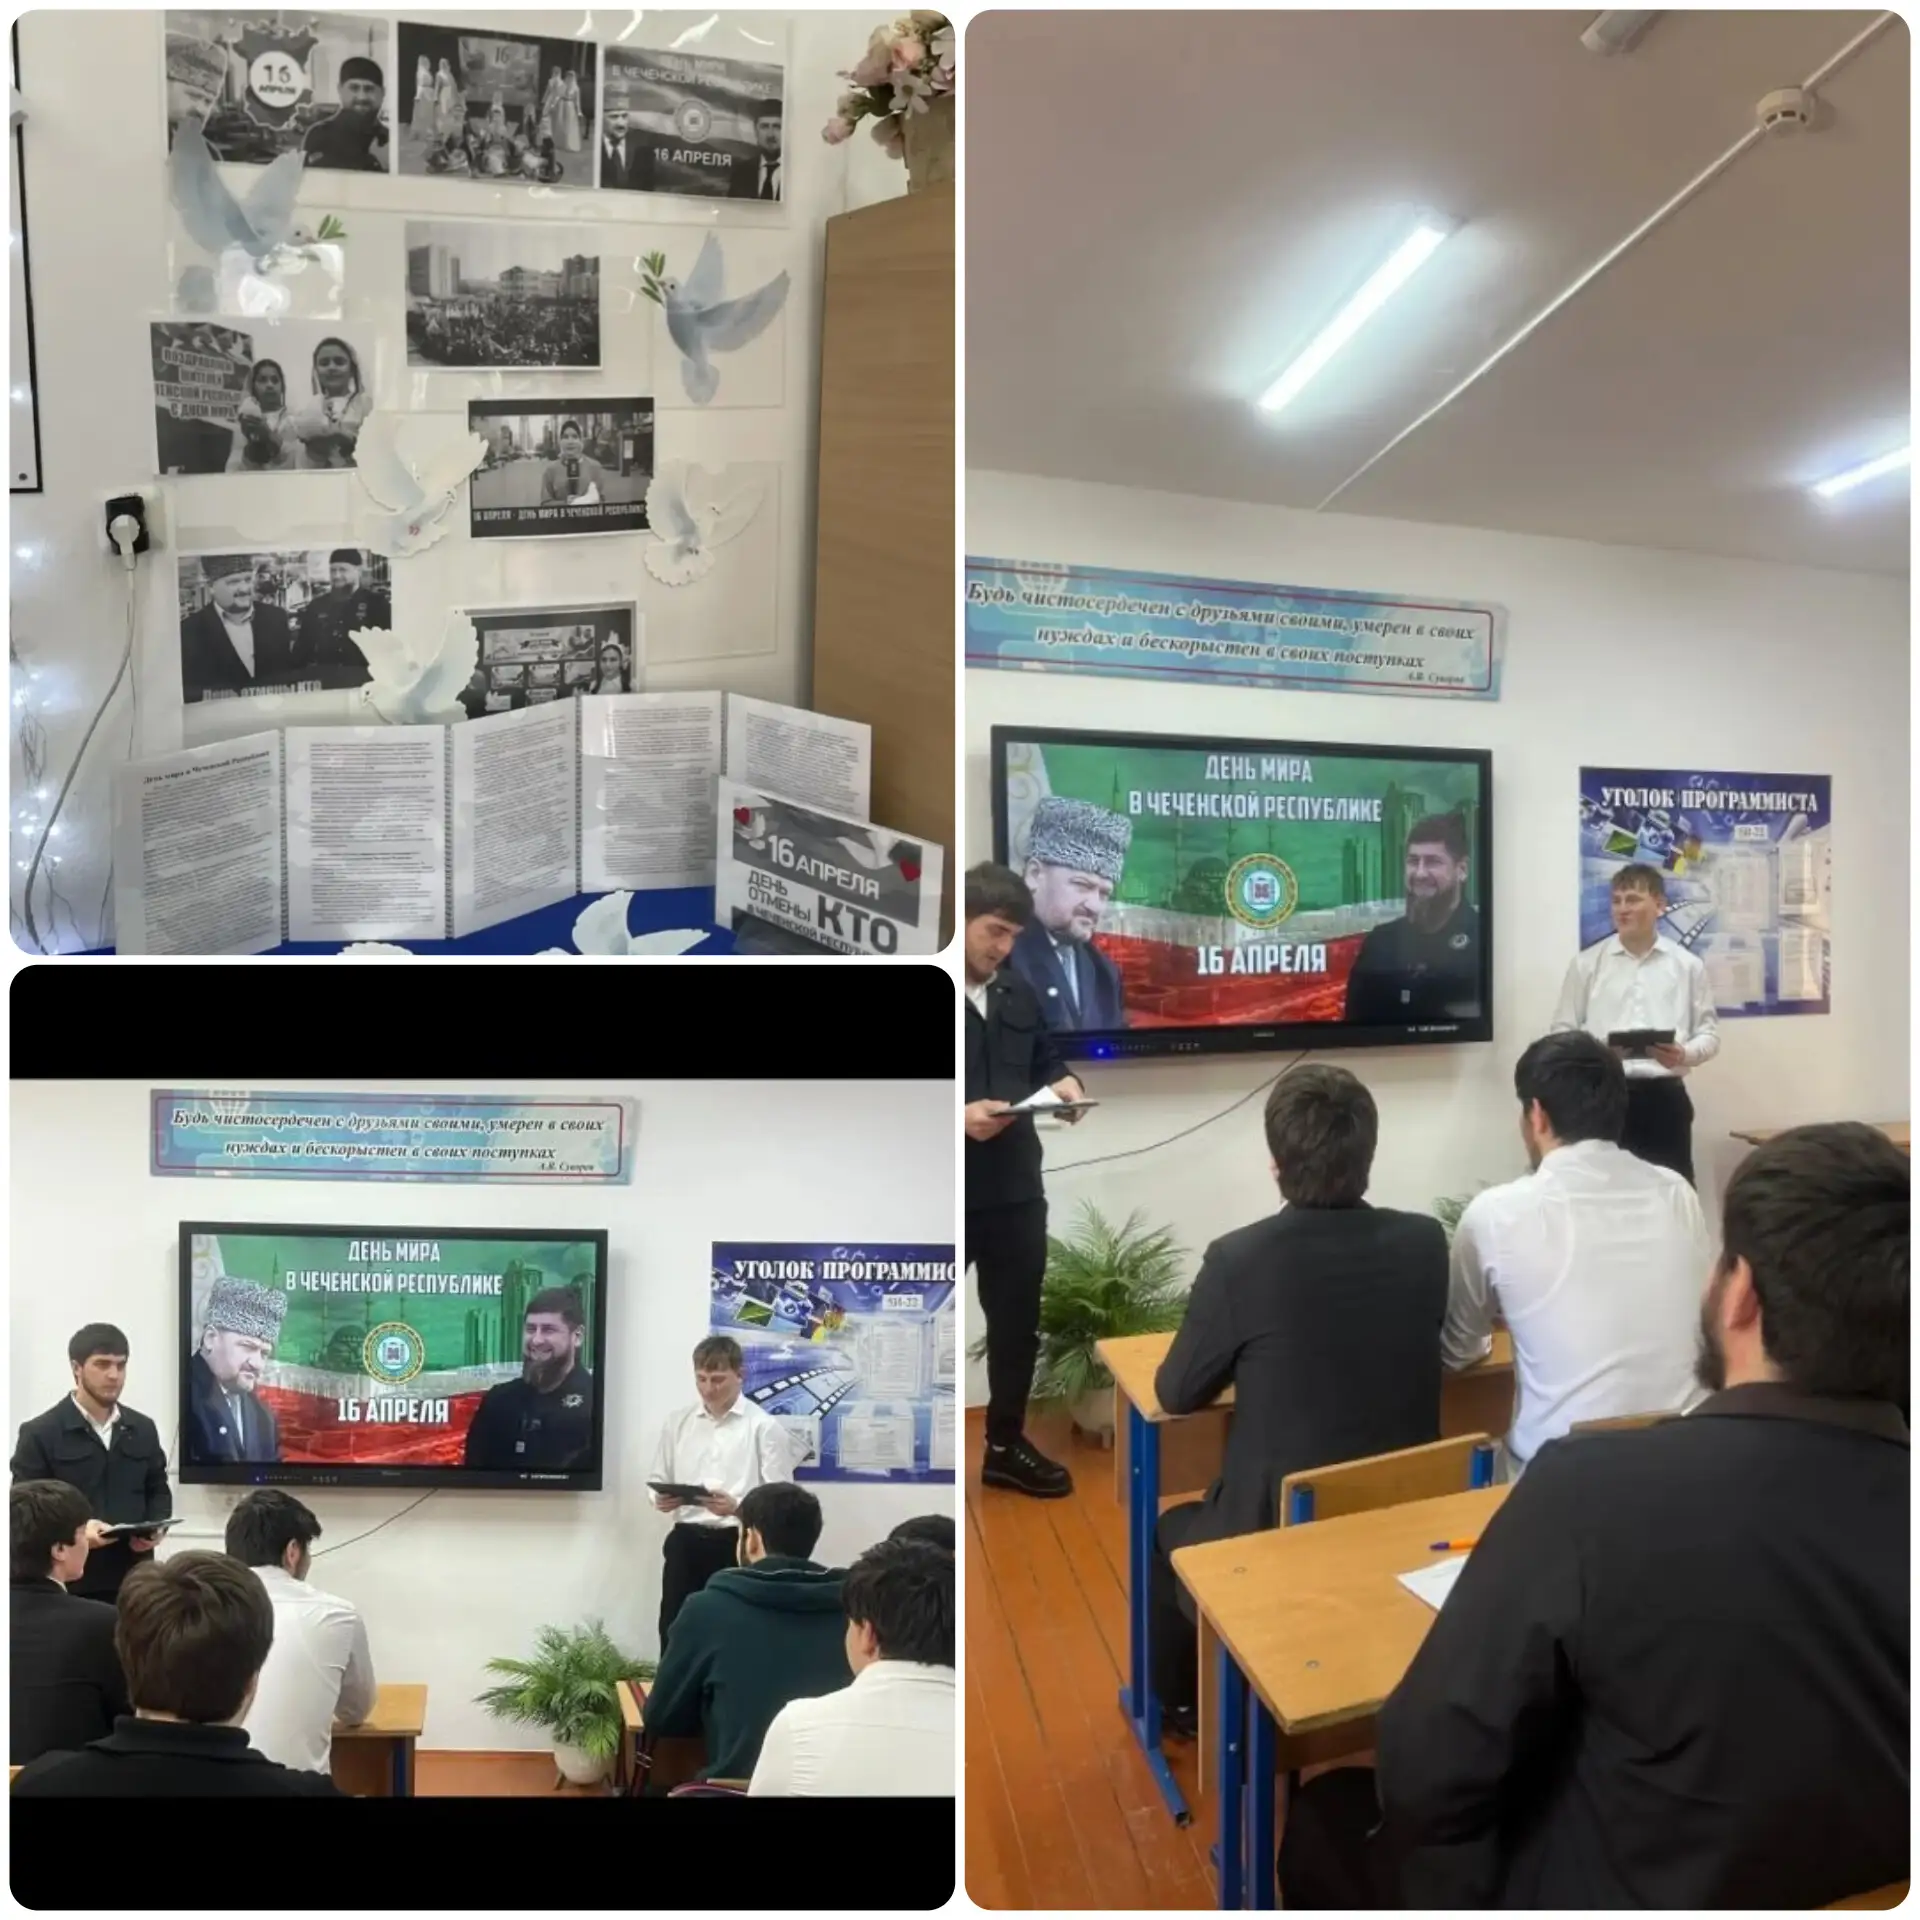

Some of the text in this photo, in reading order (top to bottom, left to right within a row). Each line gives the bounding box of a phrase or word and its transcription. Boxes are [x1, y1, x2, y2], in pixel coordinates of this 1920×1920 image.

[263, 64, 291, 83] 16
[612, 65, 621, 77] В
[654, 148, 732, 167] 16 АПРЕЛЯ
[967, 582, 1475, 640] Будь чистосердечен с друзьями своими, умерен в своих
[1037, 627, 1425, 669] нуждах и бескорыстен в своих поступках
[1205, 755, 1313, 783] ДЕНЬ МИРА
[1130, 789, 1382, 822] В ЧЕЧЕНСКОЙ РЕСПУБЛИКЕ
[1601, 786, 1818, 813] УГОЛОК ПРОГРАММИСТА
[768, 835, 880, 900] 16 АПРЕЛЯ
[748, 870, 788, 896] ДЕНЬ
[748, 887, 898, 955] ОТМЕНЫ КТО
[1198, 944, 1327, 975] 16 АПРЕЛЯ
[173, 1110, 605, 1134] Будь чистосердечен с друзьями своими, умерен в своих
[226, 1141, 556, 1161] нуждах и бескорыстен в своих поступках
[348, 1241, 440, 1263] ДЕНЬ МИРА
[286, 1269, 503, 1295] В ЧЕЧЕНСКОЙ РЕСПУБЛИКЕ
[733, 1260, 814, 1280] УГОЛОК
[338, 1398, 449, 1423] 16 АПРЕЛЯ
